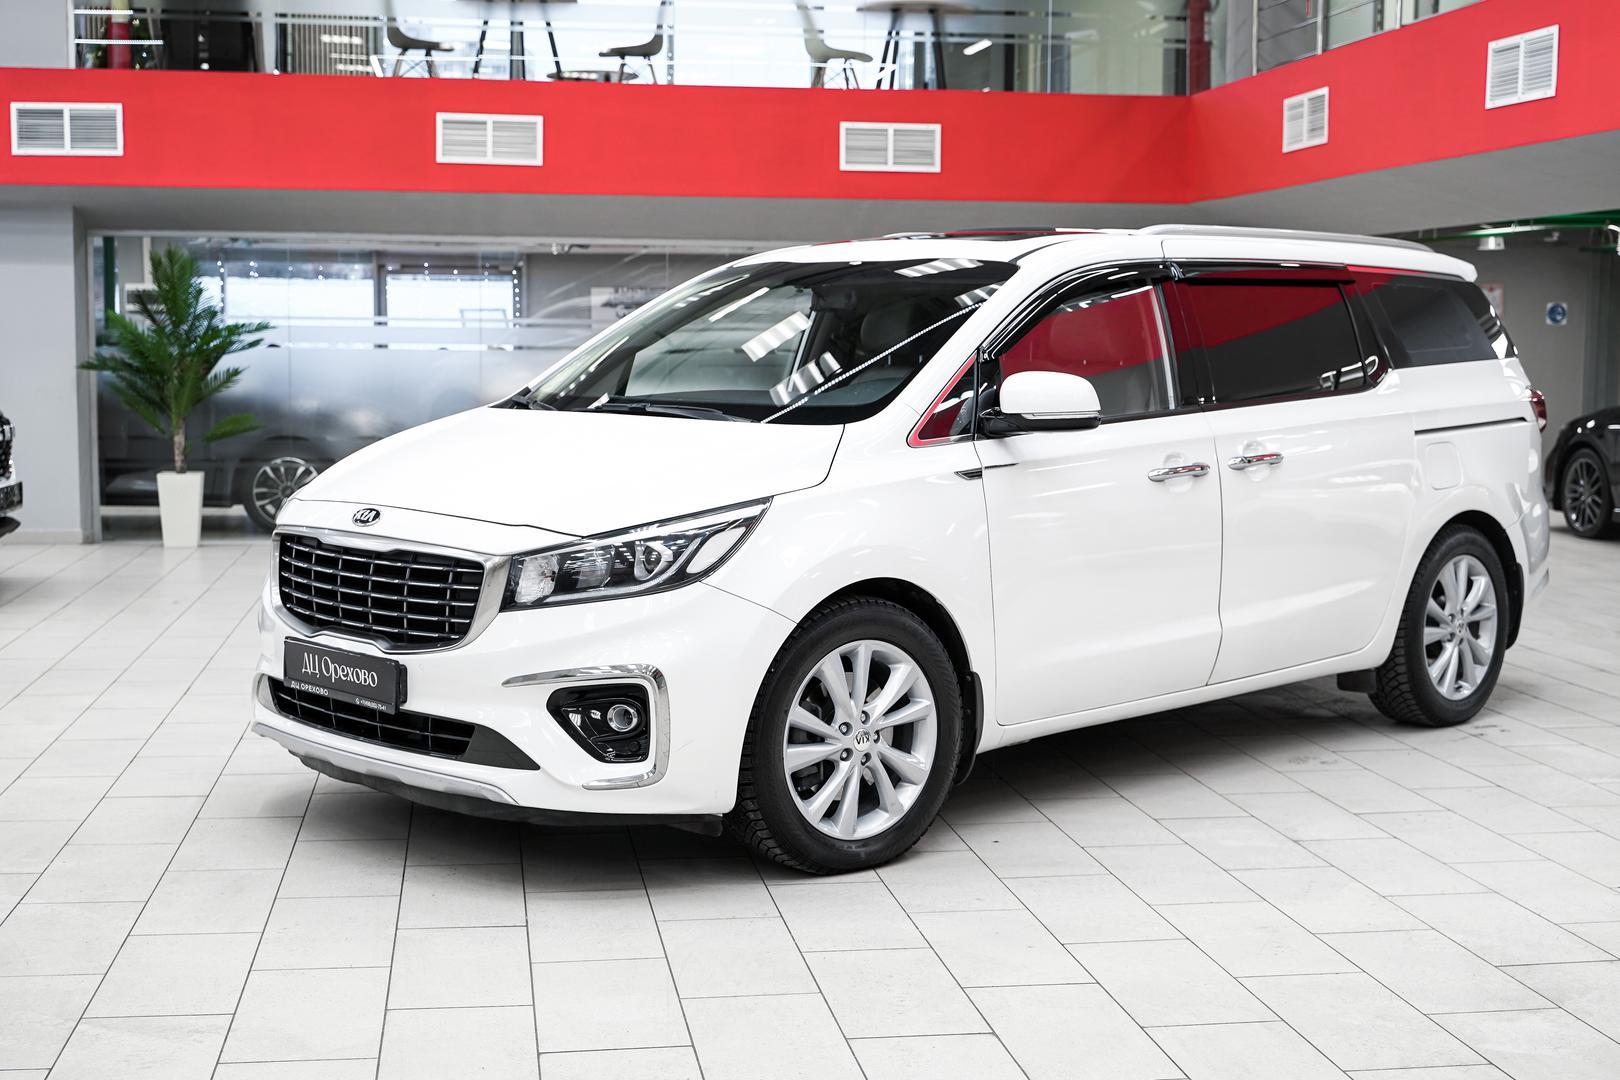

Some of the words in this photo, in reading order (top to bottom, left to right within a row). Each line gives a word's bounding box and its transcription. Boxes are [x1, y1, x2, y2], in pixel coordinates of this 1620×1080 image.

[302, 651, 320, 678] ДЦ
[321, 656, 378, 687] Орехово
[290, 680, 300, 690] ДЦ
[300, 683, 329, 696] ОРЕХОВО
